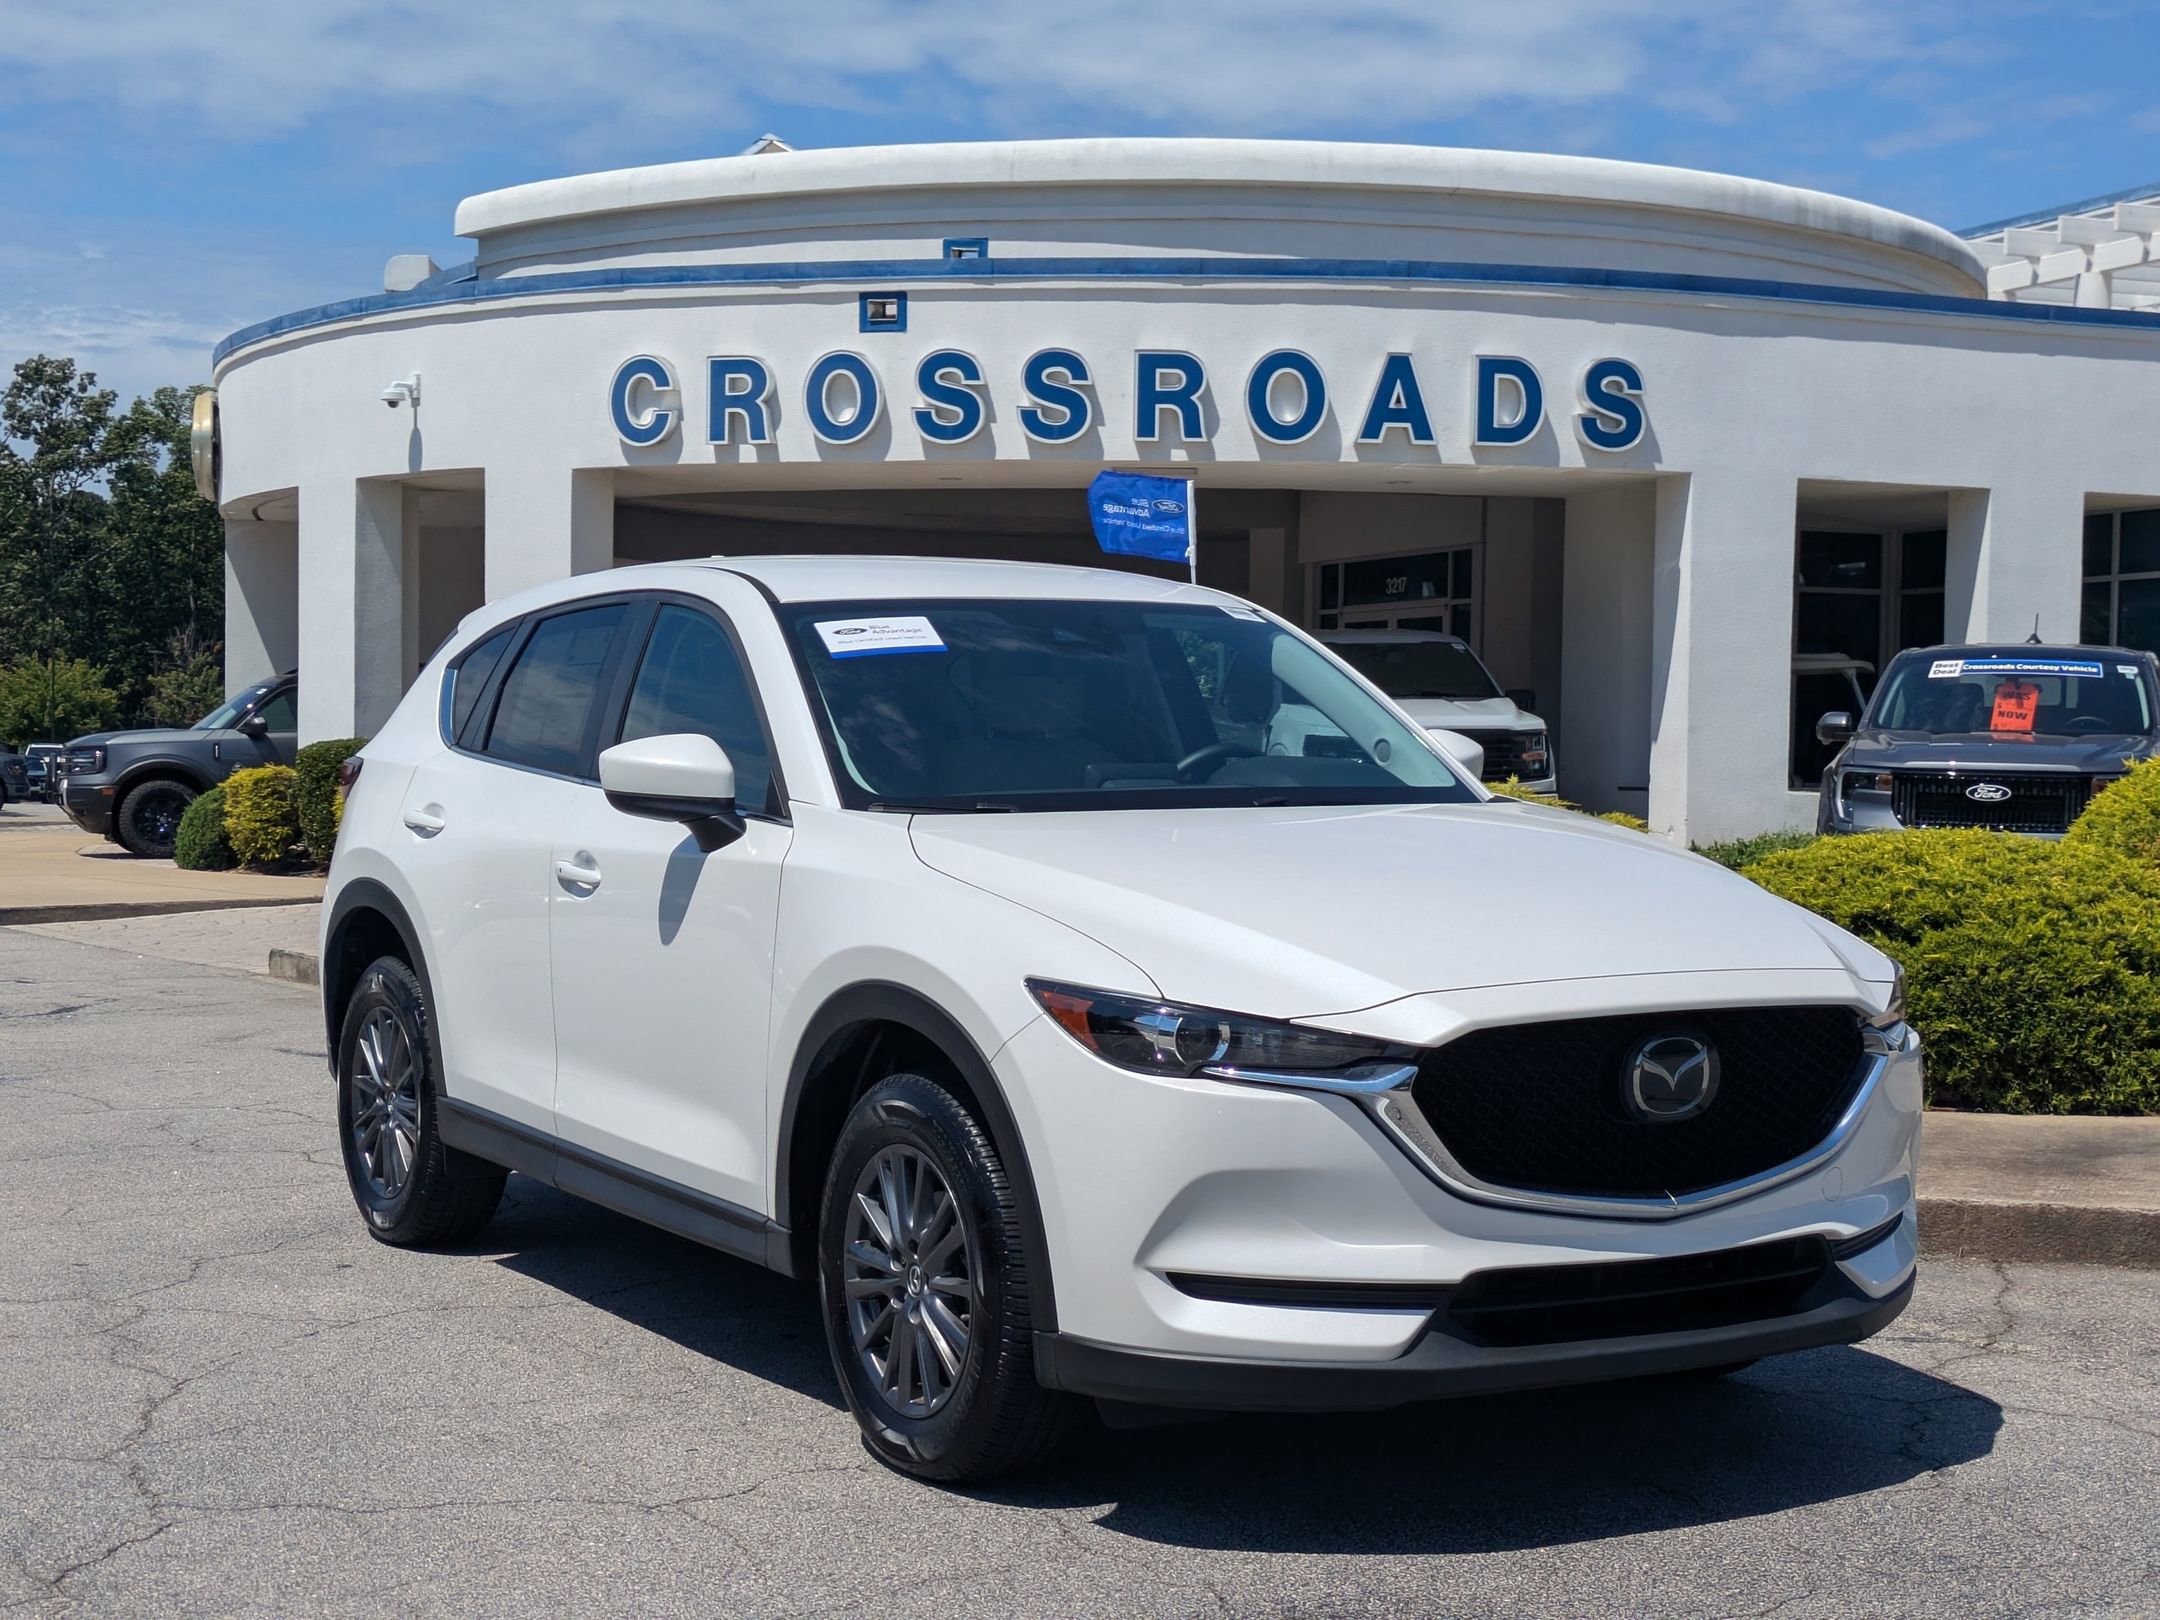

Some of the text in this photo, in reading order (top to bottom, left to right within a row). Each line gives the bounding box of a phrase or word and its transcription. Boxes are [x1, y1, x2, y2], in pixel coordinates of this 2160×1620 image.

[609, 346, 1648, 453] CROSSROADS
[1386, 577, 1408, 594] 3217
[2016, 663, 2060, 672] Courtesy
[2061, 665, 2098, 673] Vehicle
[1997, 710, 2028, 720] NOW
